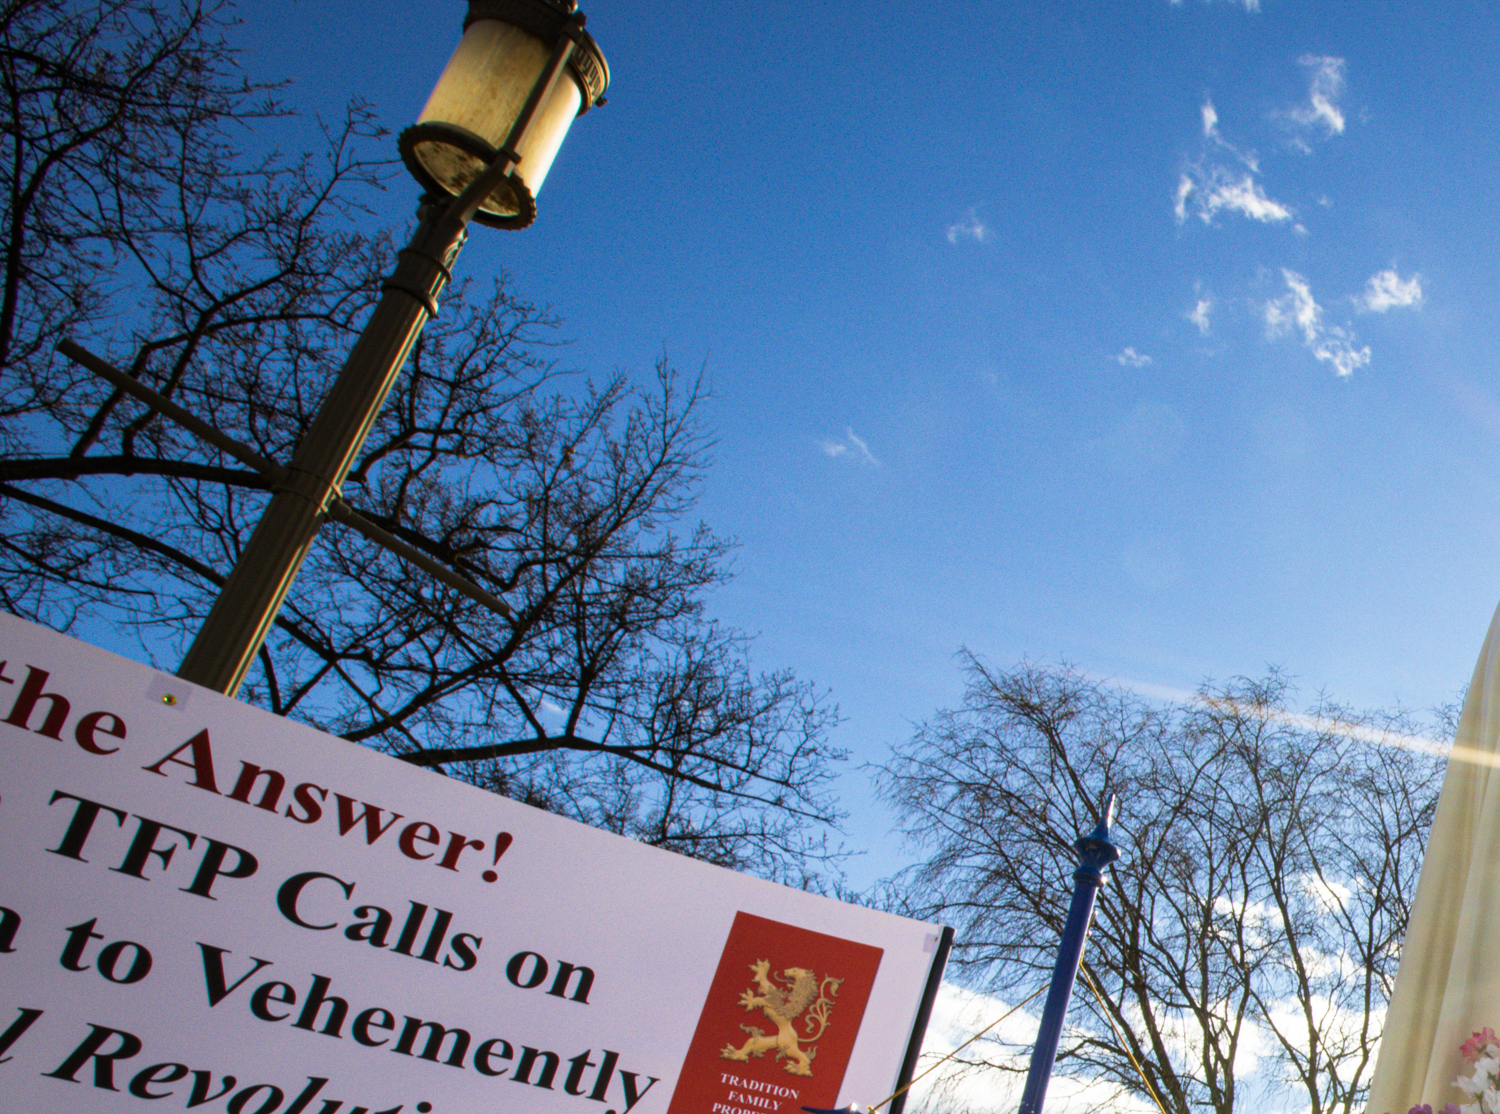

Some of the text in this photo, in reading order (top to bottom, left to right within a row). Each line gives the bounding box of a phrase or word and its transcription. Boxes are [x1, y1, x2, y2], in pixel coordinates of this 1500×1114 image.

[141, 727, 513, 883] Answer!
[45, 789, 595, 1005] TFP Calls on
[60, 917, 153, 984] to
[721, 1073, 799, 1099] TRADITION
[728, 1091, 782, 1110] FAMILY
